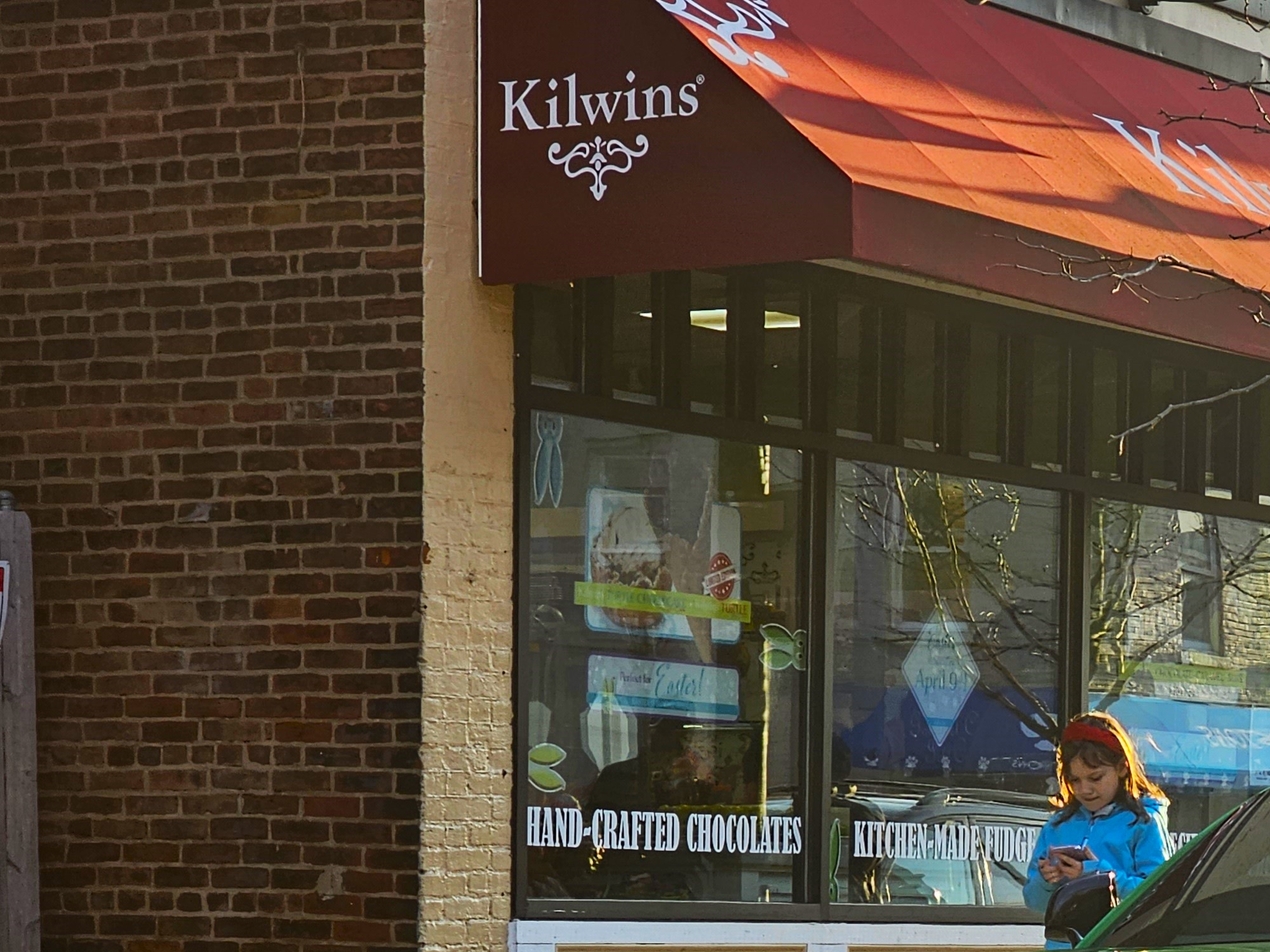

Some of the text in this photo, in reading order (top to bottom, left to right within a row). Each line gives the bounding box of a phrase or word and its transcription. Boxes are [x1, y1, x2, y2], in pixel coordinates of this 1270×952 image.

[915, 669, 945, 695] April
[526, 806, 802, 855] HAND-CRAFTED CHOCOLATES
[853, 820, 980, 861] KITCHEN-MADE
